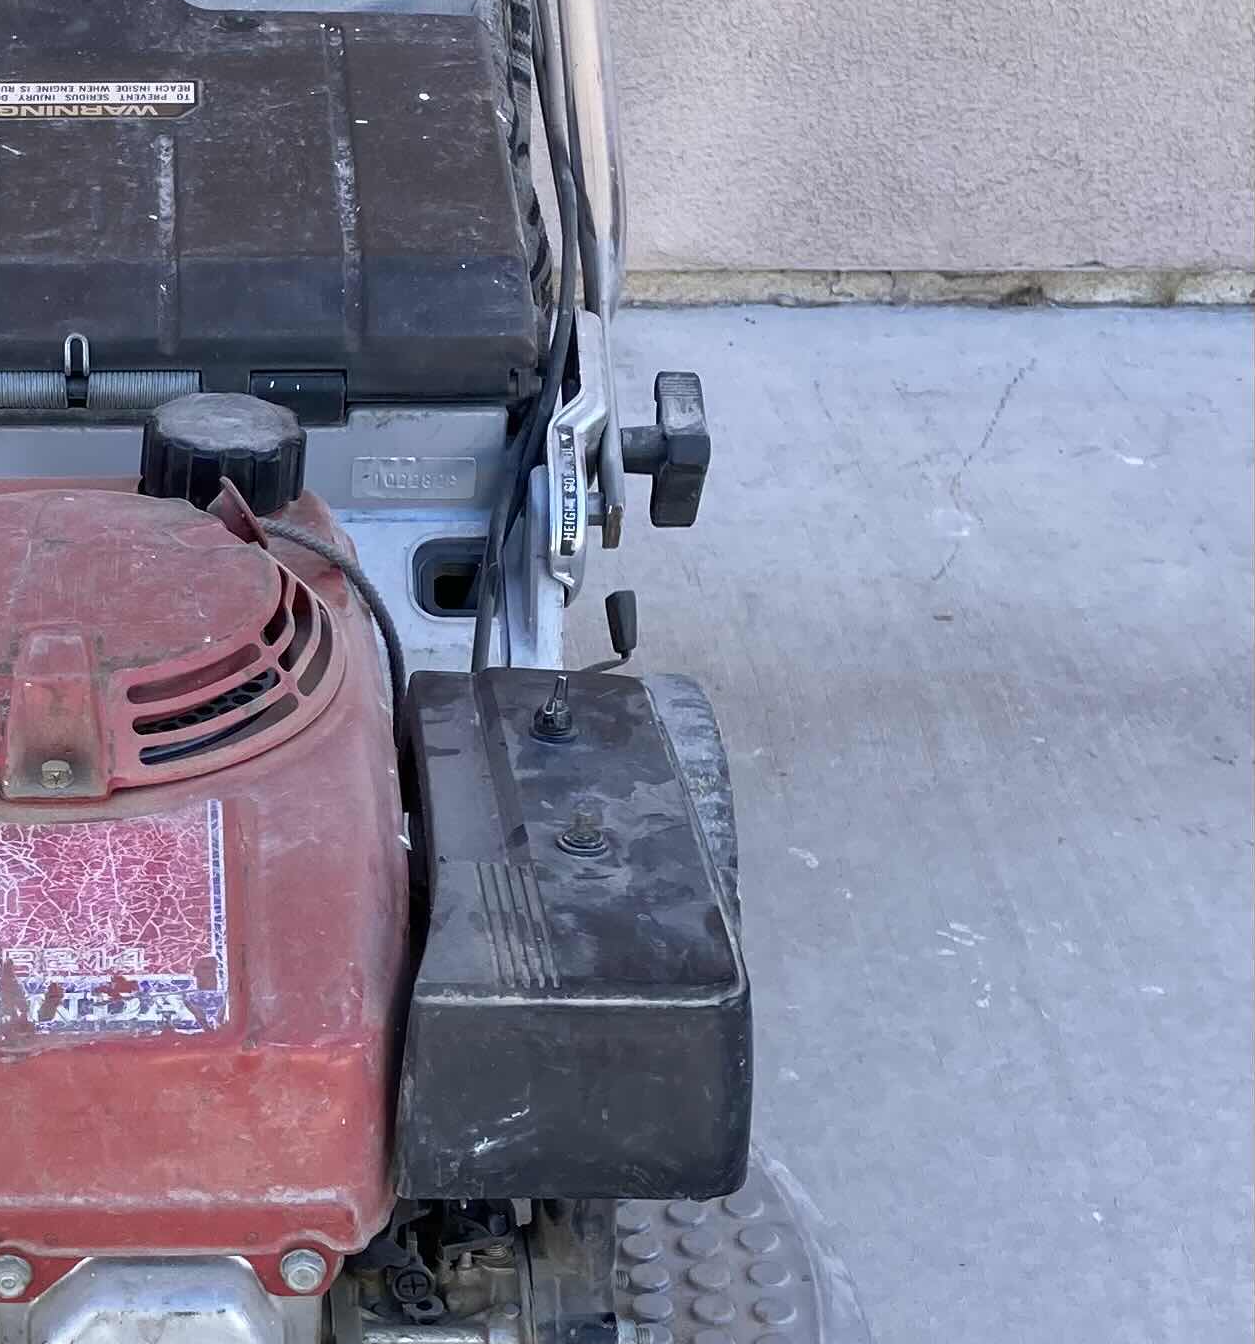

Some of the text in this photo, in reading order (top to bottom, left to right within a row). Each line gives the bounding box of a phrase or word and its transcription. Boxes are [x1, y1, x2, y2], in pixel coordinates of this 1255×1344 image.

[19, 85, 31, 93] IS
[36, 84, 74, 93] ENGINE
[79, 84, 111, 93] WHEN
[116, 84, 151, 93] INSIDE
[155, 84, 191, 93] REACH
[65, 93, 110, 102] SERIOUS
[119, 93, 167, 102] PREVENT
[176, 93, 191, 102] TO
